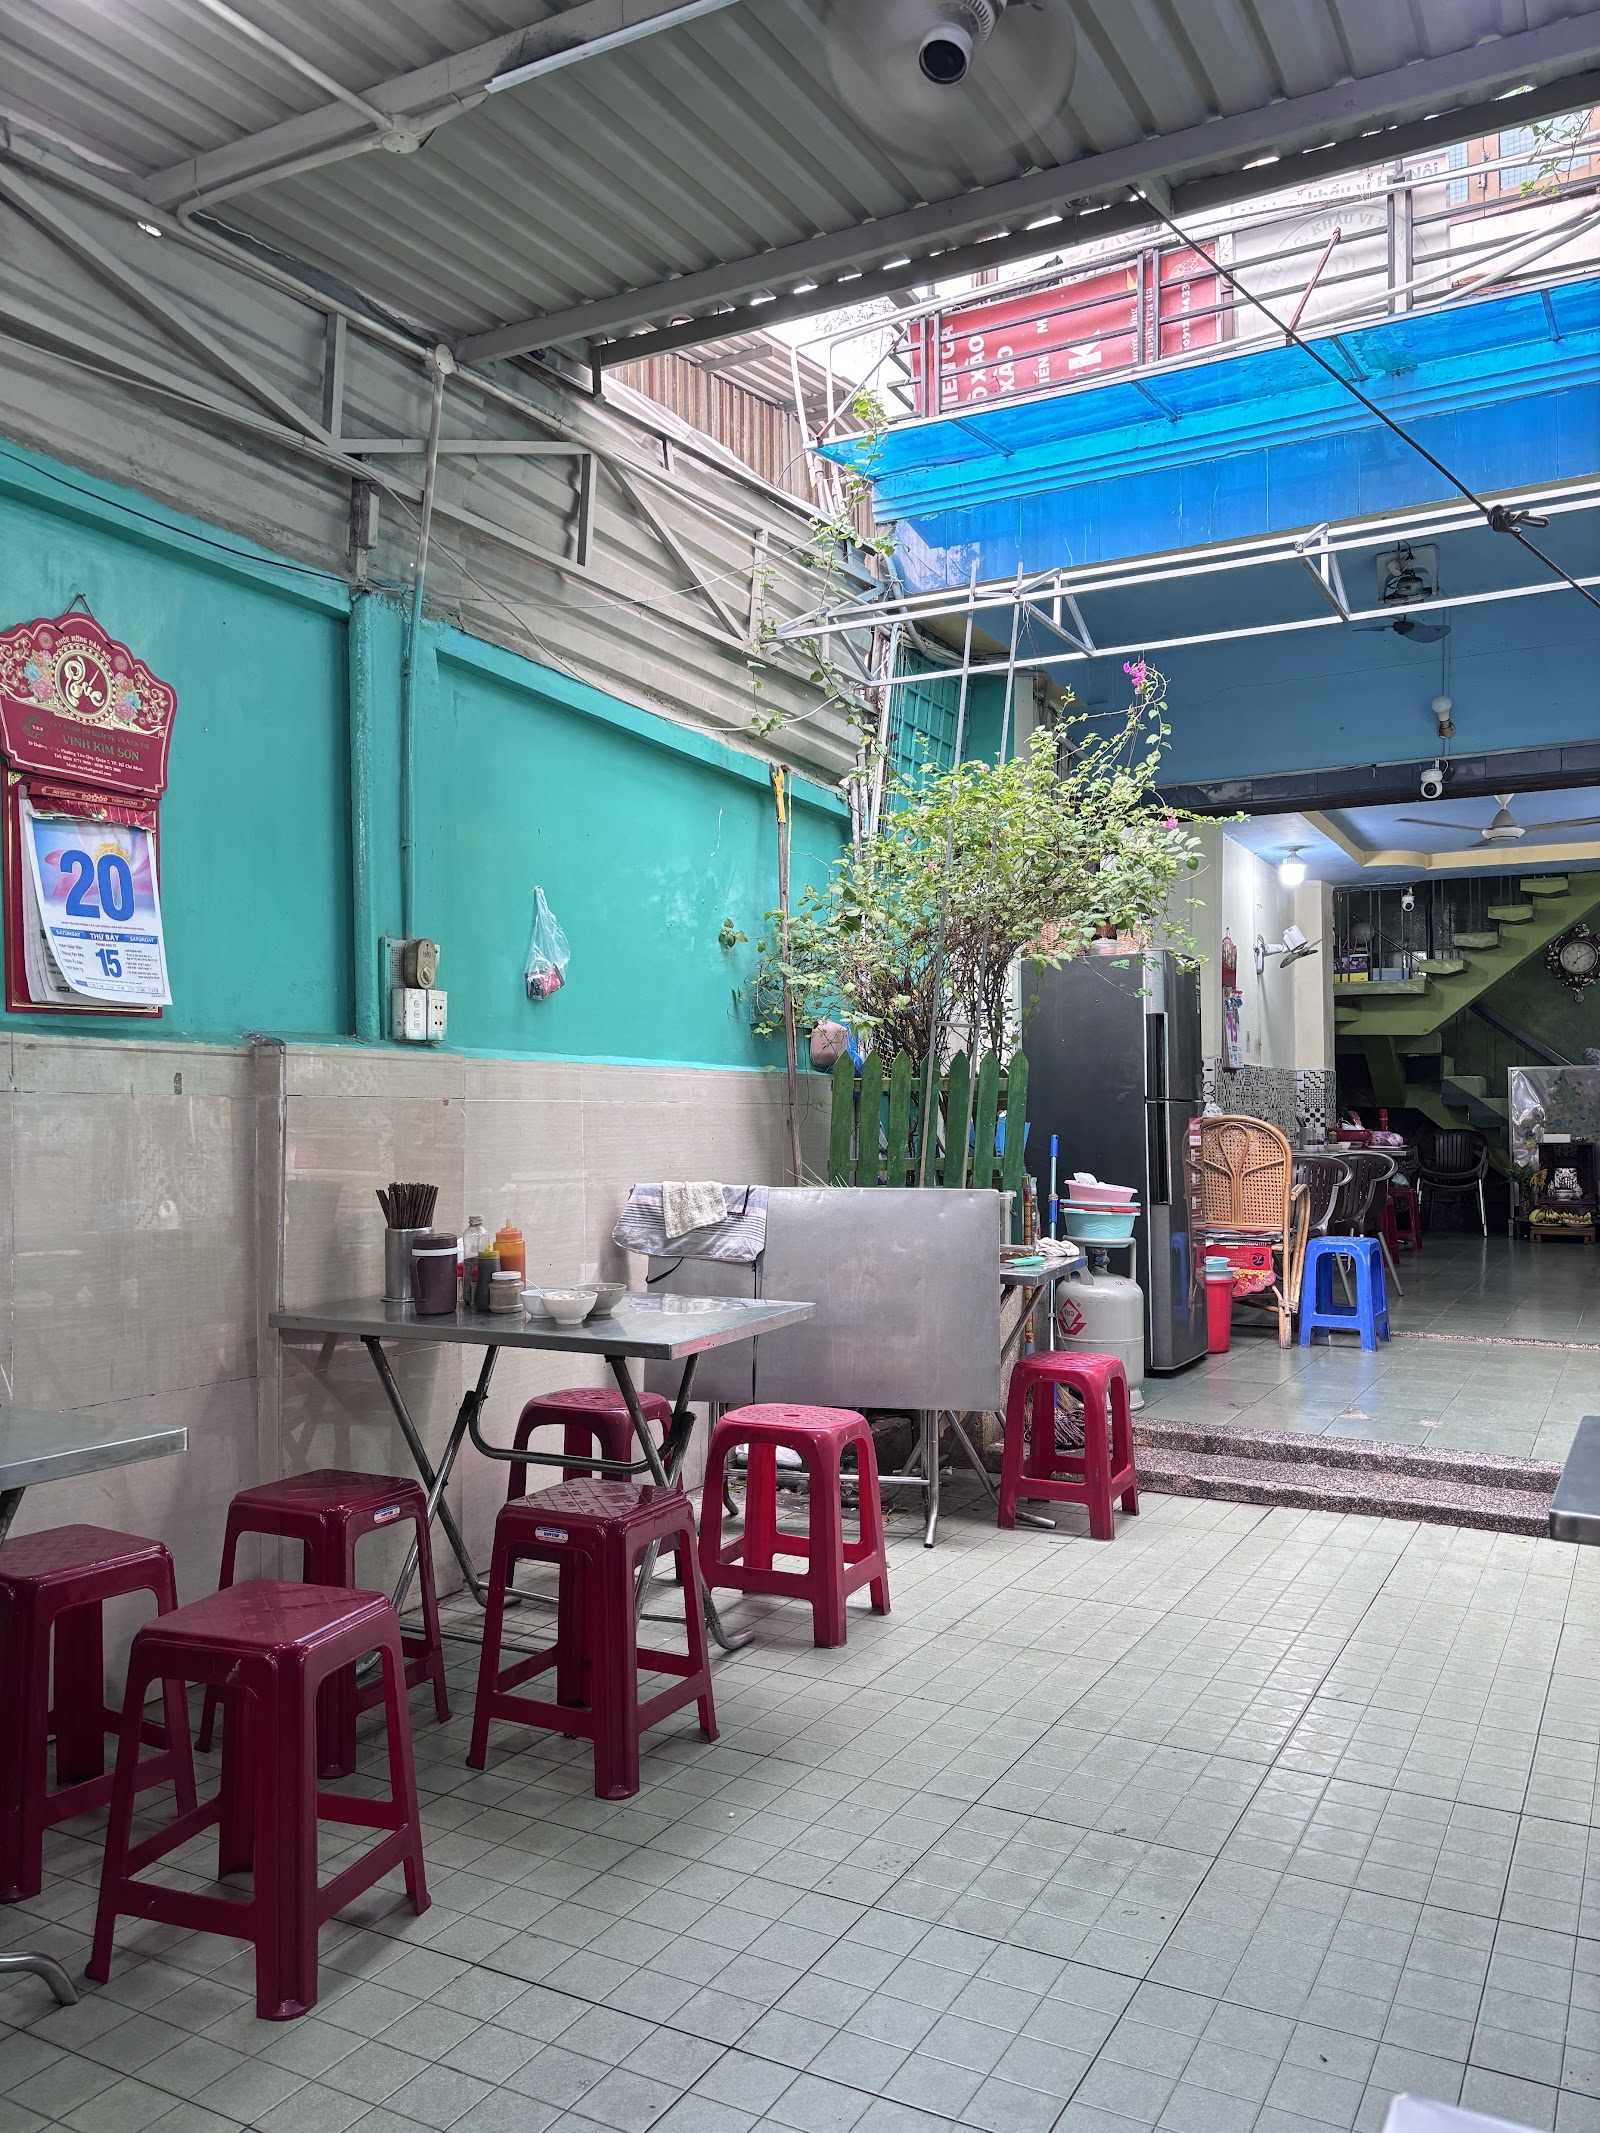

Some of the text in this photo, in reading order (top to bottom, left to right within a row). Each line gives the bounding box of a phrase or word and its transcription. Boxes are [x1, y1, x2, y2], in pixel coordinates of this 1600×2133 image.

[1312, 209, 1354, 236] KHẨU
[964, 335, 987, 385] XÀO
[993, 346, 1015, 393] XÀO
[1033, 356, 1051, 385] IẾN
[59, 849, 135, 922] 20
[129, 935, 155, 943] SATURDAY
[95, 948, 123, 979] 15
